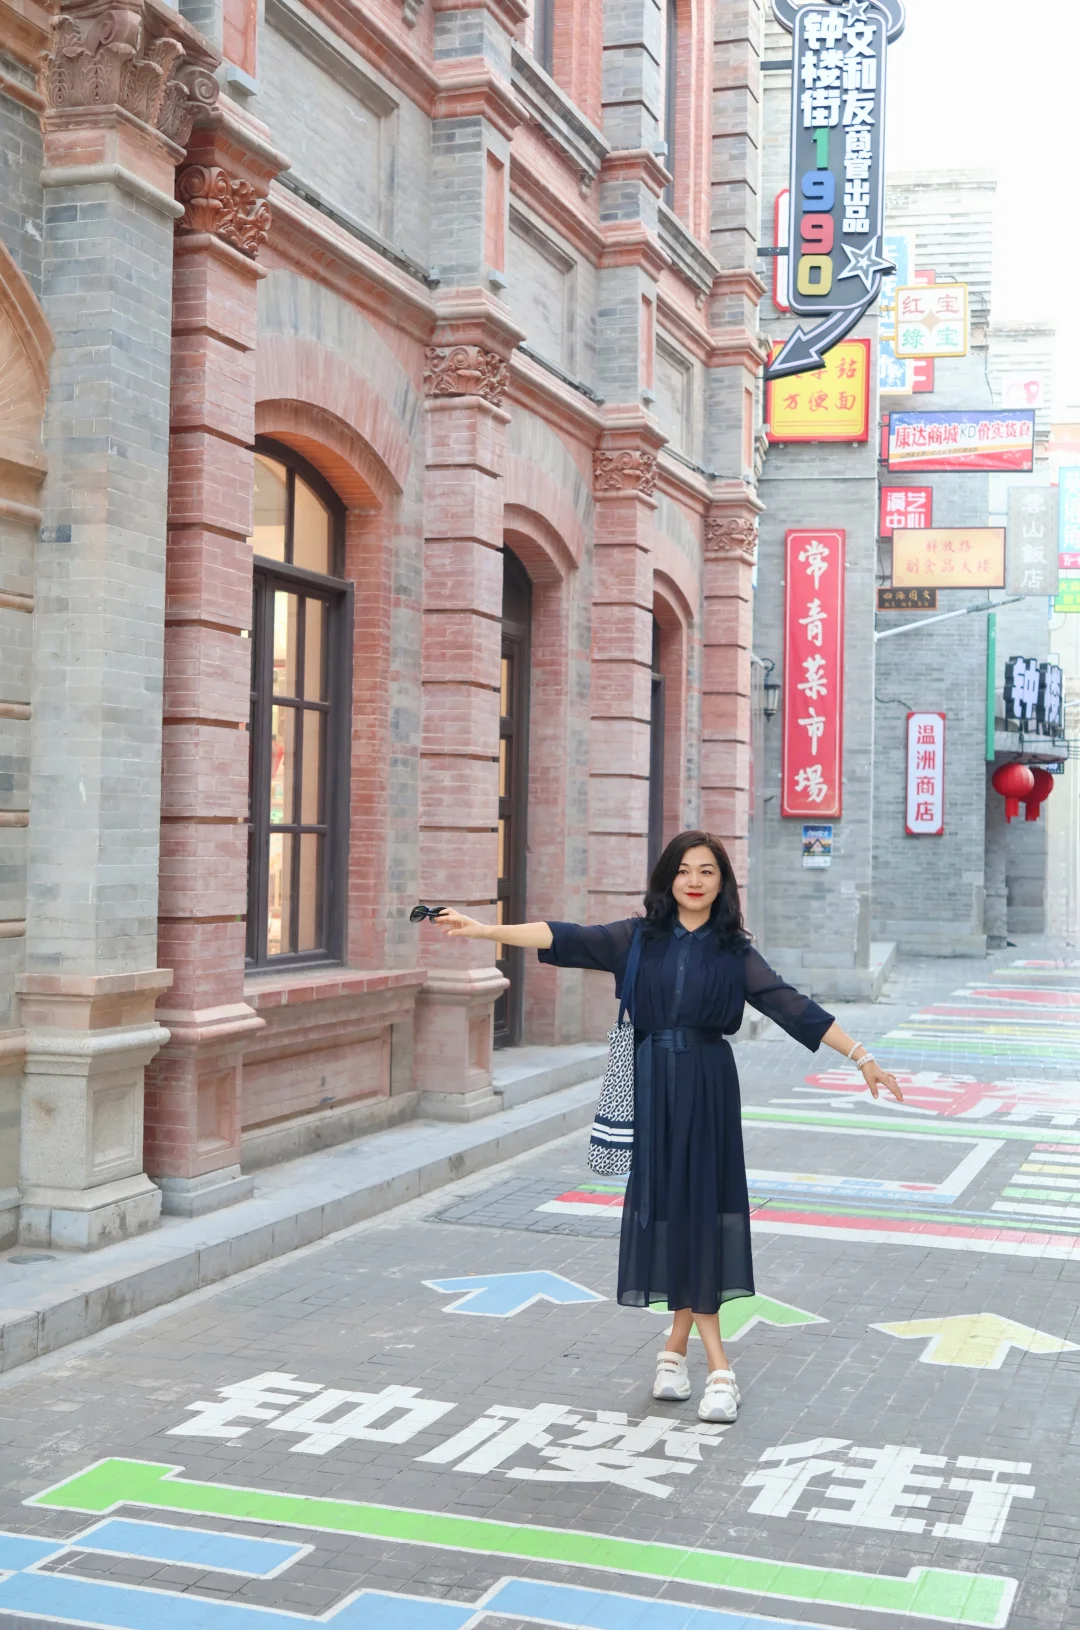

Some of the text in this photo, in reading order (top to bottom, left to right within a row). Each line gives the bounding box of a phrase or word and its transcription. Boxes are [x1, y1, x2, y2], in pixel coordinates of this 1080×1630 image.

[902, 294, 961, 316] 红宝
[783, 390, 857, 413] 方便面
[914, 724, 937, 823] 温洲商店
[165, 1371, 1036, 1545] 钟楼街
